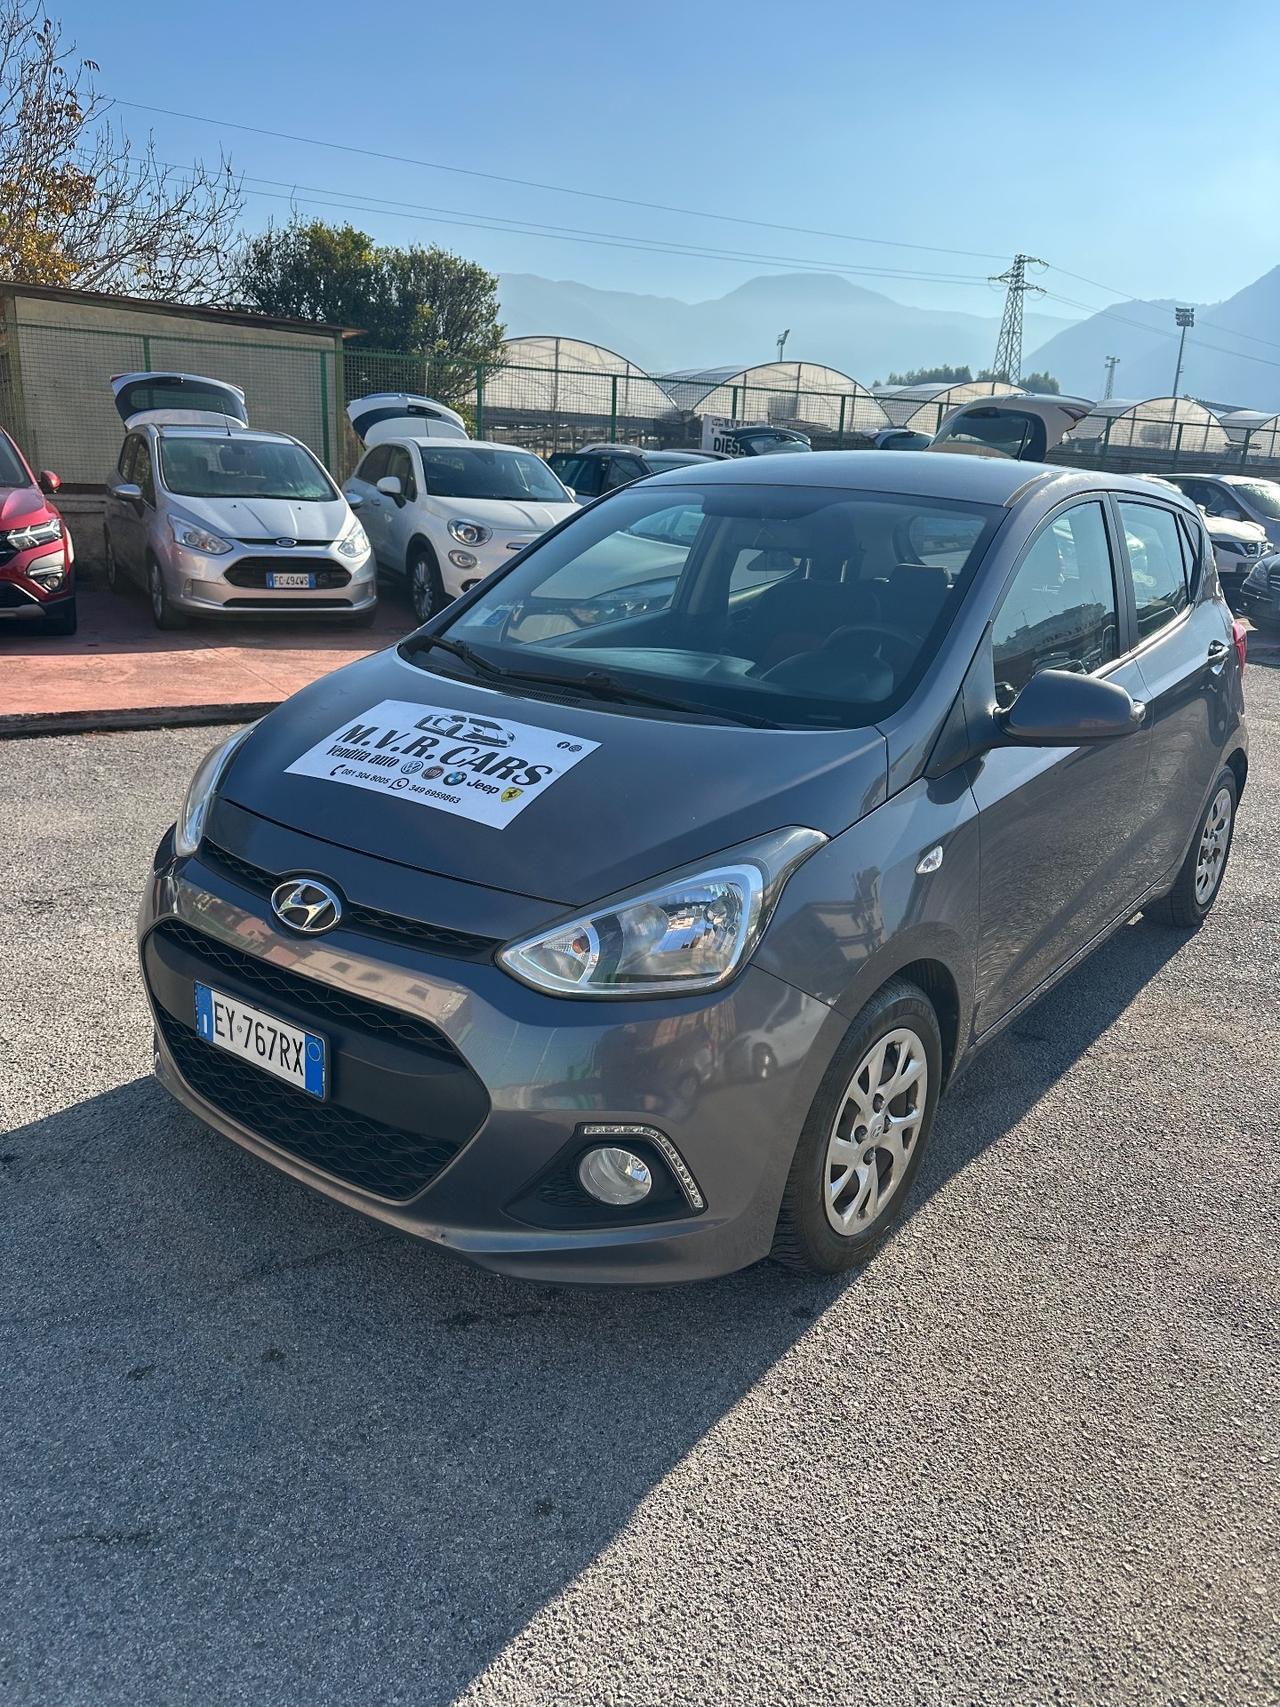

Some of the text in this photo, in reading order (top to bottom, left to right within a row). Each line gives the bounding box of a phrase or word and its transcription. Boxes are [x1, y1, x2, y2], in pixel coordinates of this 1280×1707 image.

[326, 744, 400, 768] Vendita auto
[355, 771, 370, 780] 304
[369, 774, 392, 785] 8005
[408, 784, 426, 794] 349
[424, 788, 462, 804] 6959863
[466, 779, 500, 795] Jeep
